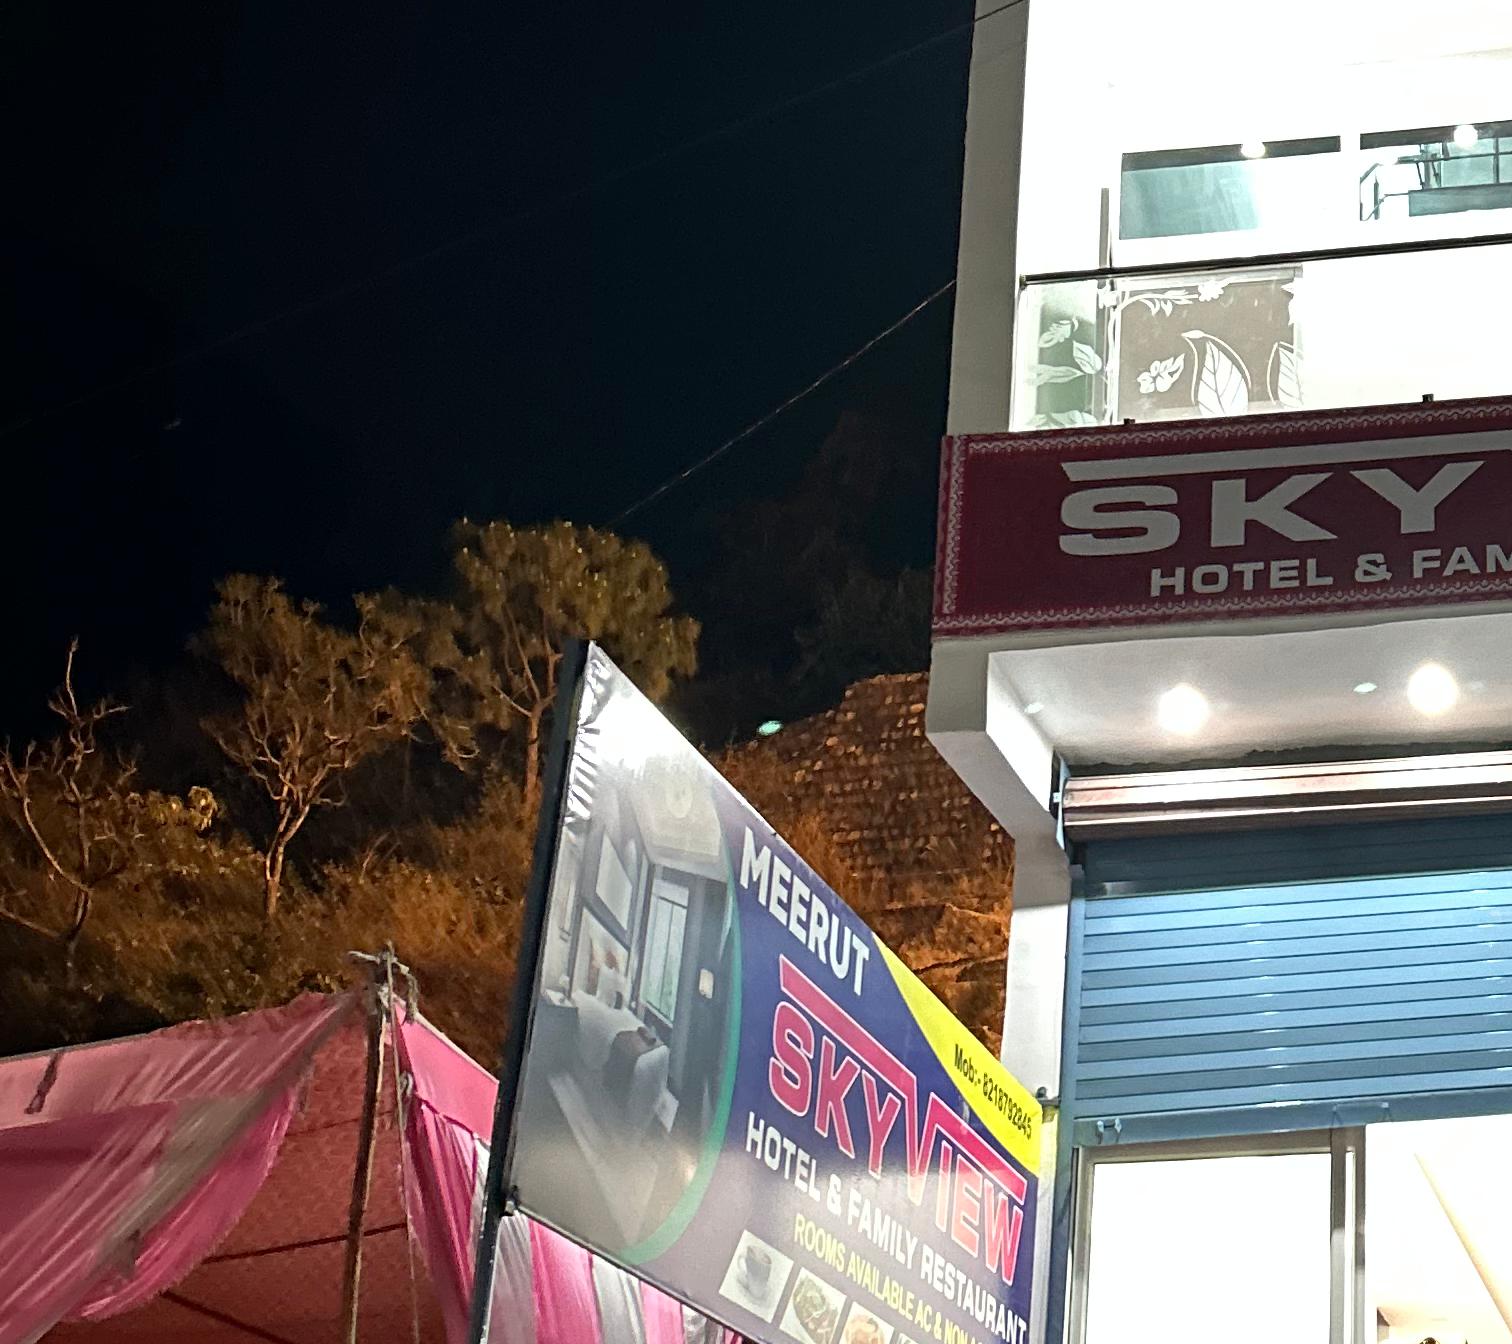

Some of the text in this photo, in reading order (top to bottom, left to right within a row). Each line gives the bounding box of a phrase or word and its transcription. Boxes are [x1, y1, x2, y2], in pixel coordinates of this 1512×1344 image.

[1150, 559, 1334, 598] HOTEL
[1353, 552, 1392, 582] &
[739, 825, 870, 996] MEERUT
[982, 1072, 1032, 1140] 8218792845
[746, 1111, 821, 1202] HOTEL
[826, 1173, 841, 1217] &
[847, 1191, 919, 1270] FAMILY
[794, 1213, 846, 1273] ROOMS
[847, 1256, 914, 1319] AVAILABLE
[914, 1299, 932, 1333] AC
